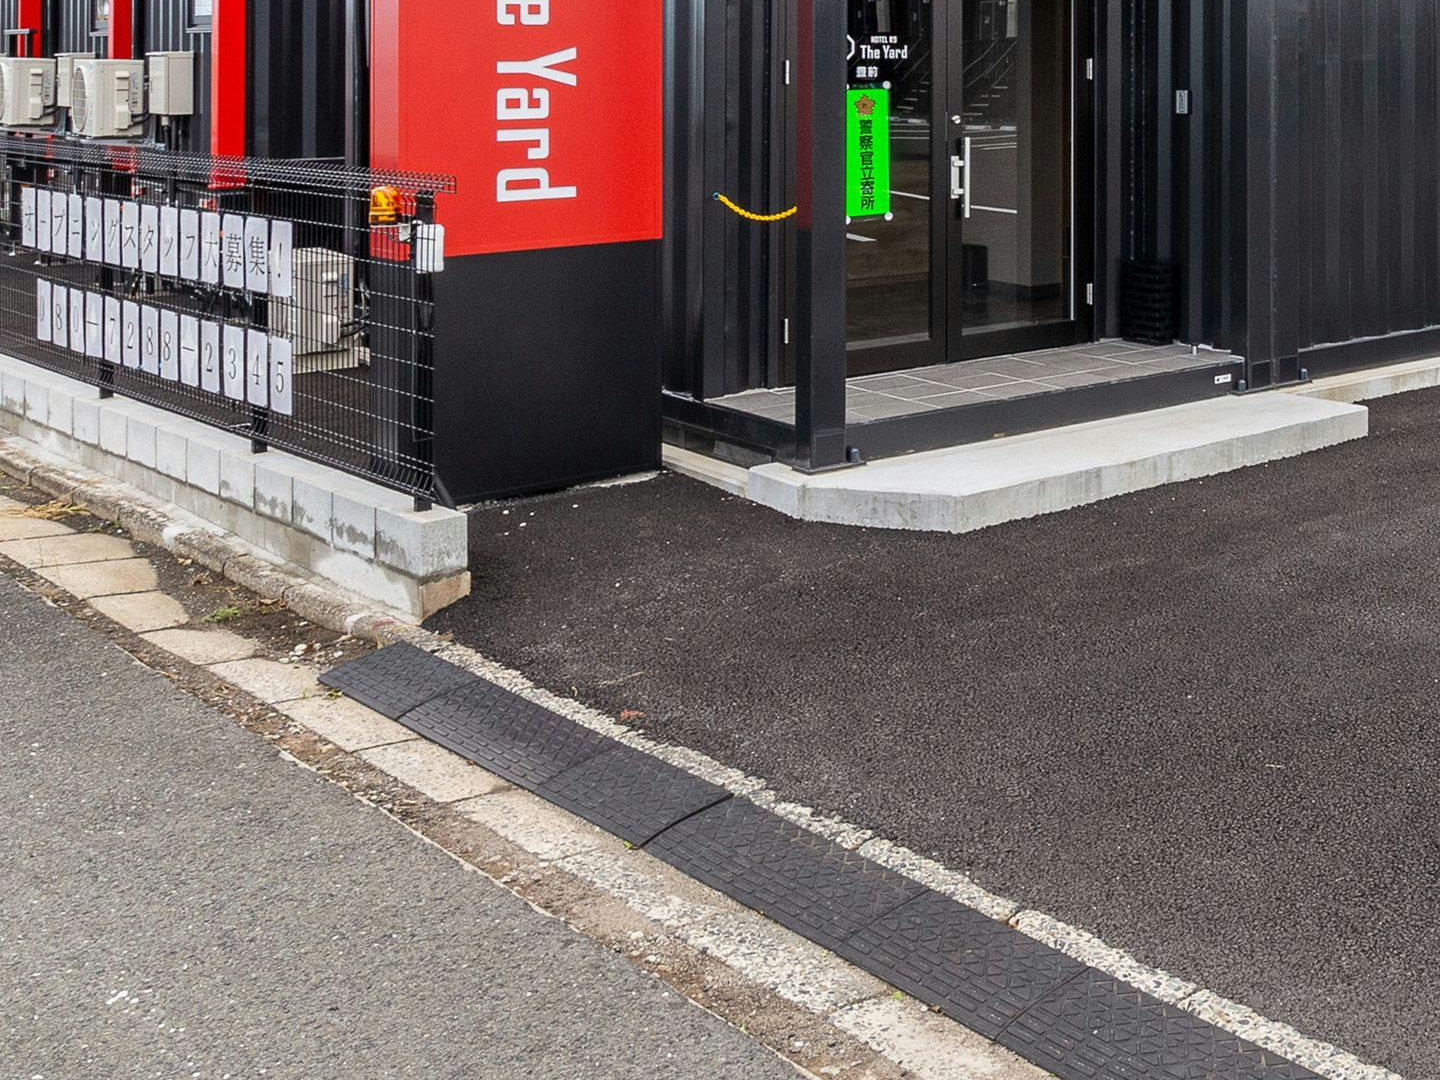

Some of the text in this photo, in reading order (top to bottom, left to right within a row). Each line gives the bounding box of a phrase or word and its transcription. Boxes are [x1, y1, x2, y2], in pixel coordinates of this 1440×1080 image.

[860, 45, 908, 59] The Yard
[496, 46, 577, 203] Yard
